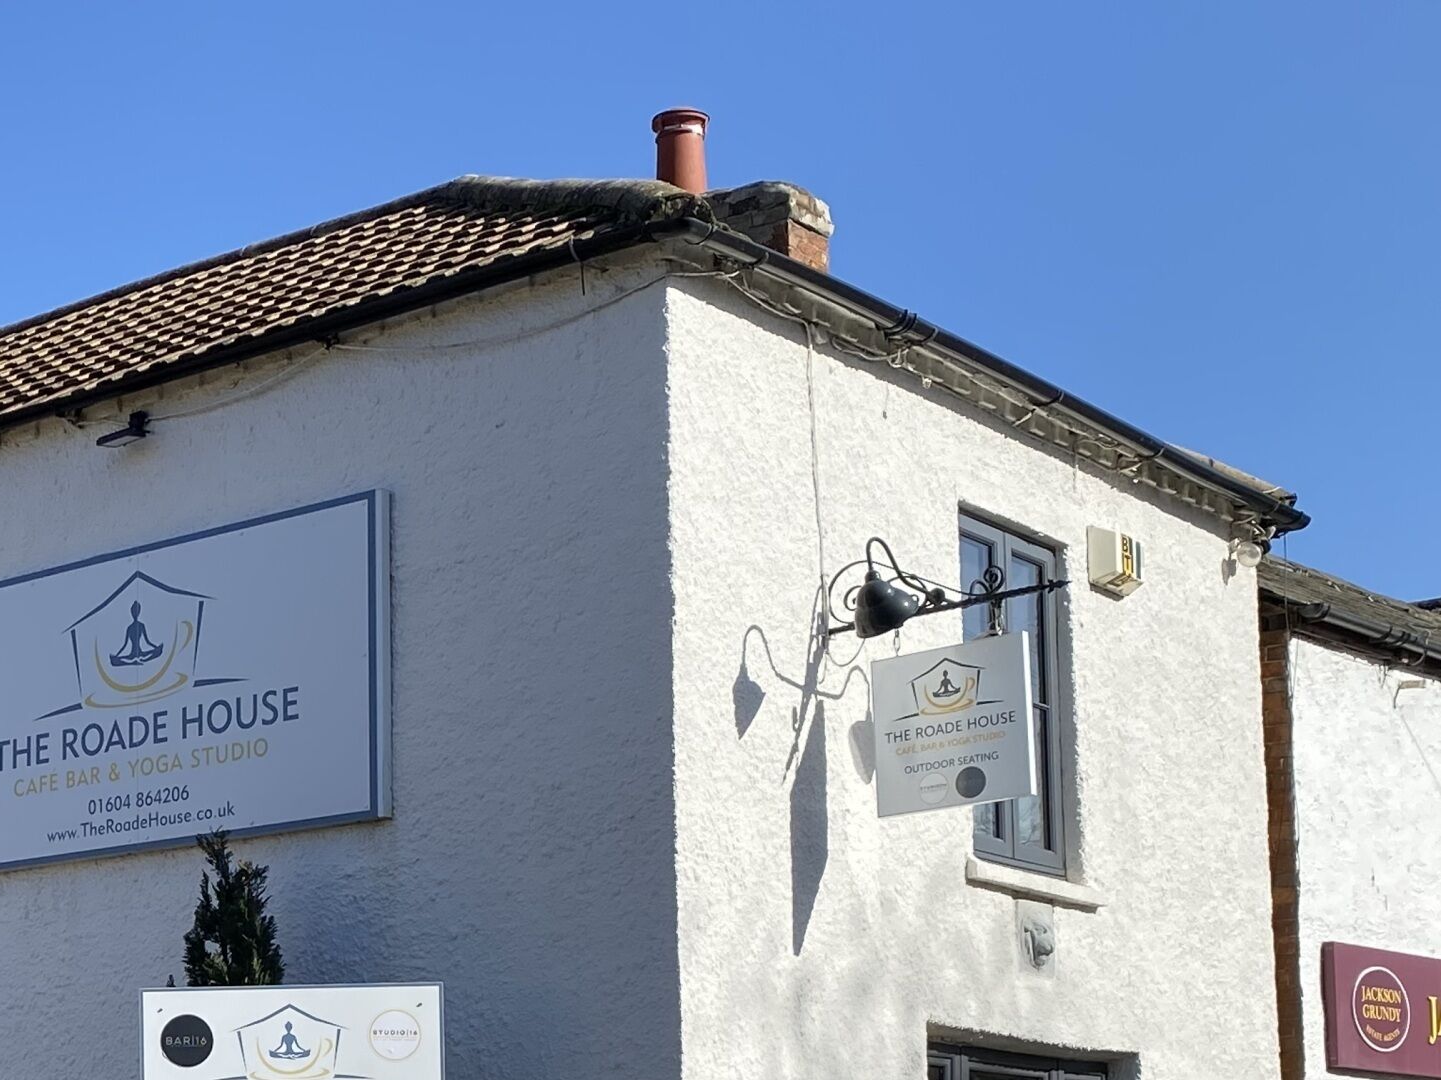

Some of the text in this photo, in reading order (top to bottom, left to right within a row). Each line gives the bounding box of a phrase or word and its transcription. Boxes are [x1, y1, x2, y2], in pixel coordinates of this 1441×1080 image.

[62, 710, 169, 761] ROADE
[181, 686, 300, 740] HOUSE
[885, 710, 1017, 745] THE ROADE HOUSE
[947, 736, 971, 748] YOGA
[971, 730, 1007, 743] STUDIO
[66, 766, 101, 789] BAR
[108, 762, 121, 782] &
[127, 752, 183, 778] YOGA
[191, 738, 269, 769] STUDIO
[904, 750, 1000, 775] OUTDOOR SEATING
[88, 784, 190, 815] 01604 864206
[47, 800, 236, 843] www.TheRoadeHouse.co.uk
[1361, 985, 1402, 1003] JACKSON
[1362, 1003, 1402, 1022] GRUNDY
[1428, 995, 1441, 1045] J
